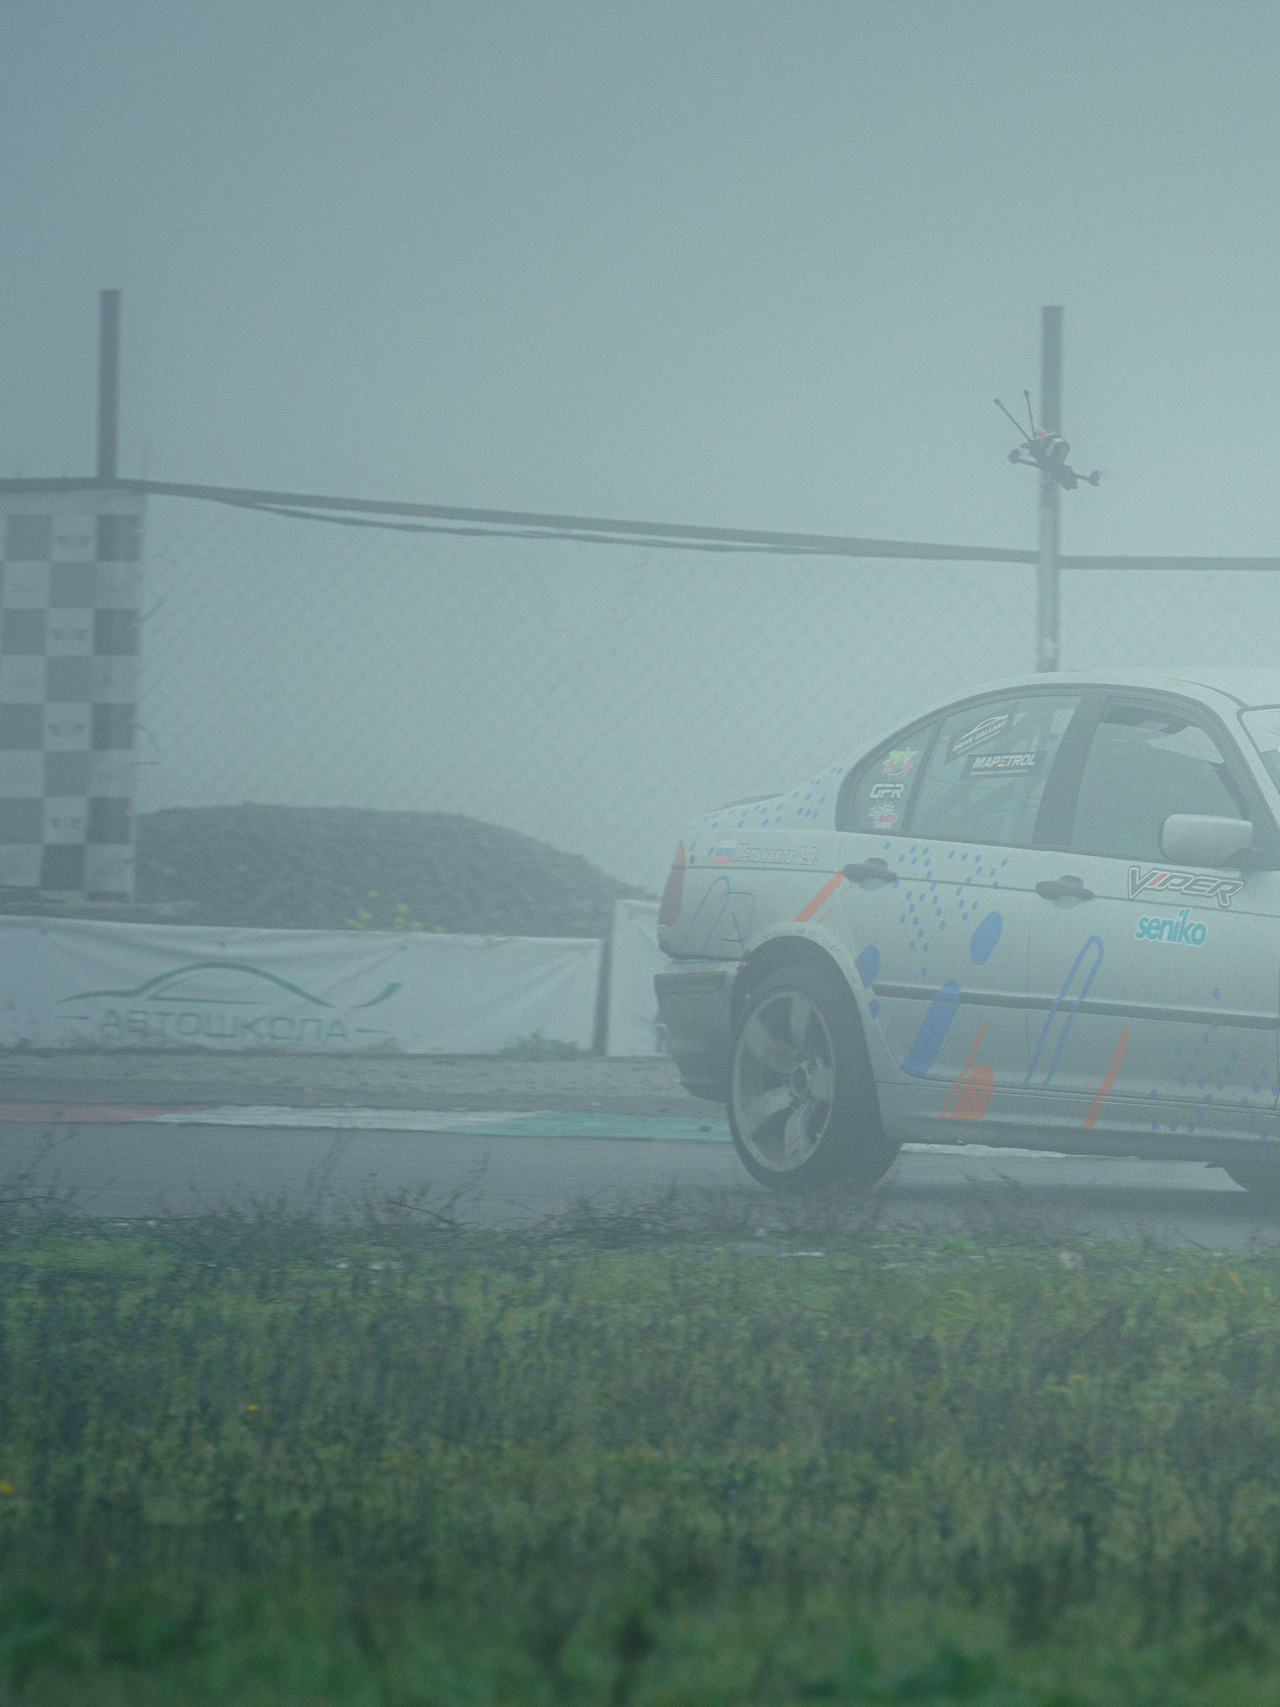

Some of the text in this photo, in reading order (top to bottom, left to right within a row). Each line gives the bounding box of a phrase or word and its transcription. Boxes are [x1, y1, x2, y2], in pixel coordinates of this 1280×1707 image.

[972, 754, 1036, 769] MAPETROL
[1128, 866, 1246, 908] VIPER
[1134, 908, 1209, 947] seniko
[101, 1008, 350, 1044] АВТОШКОЛА
